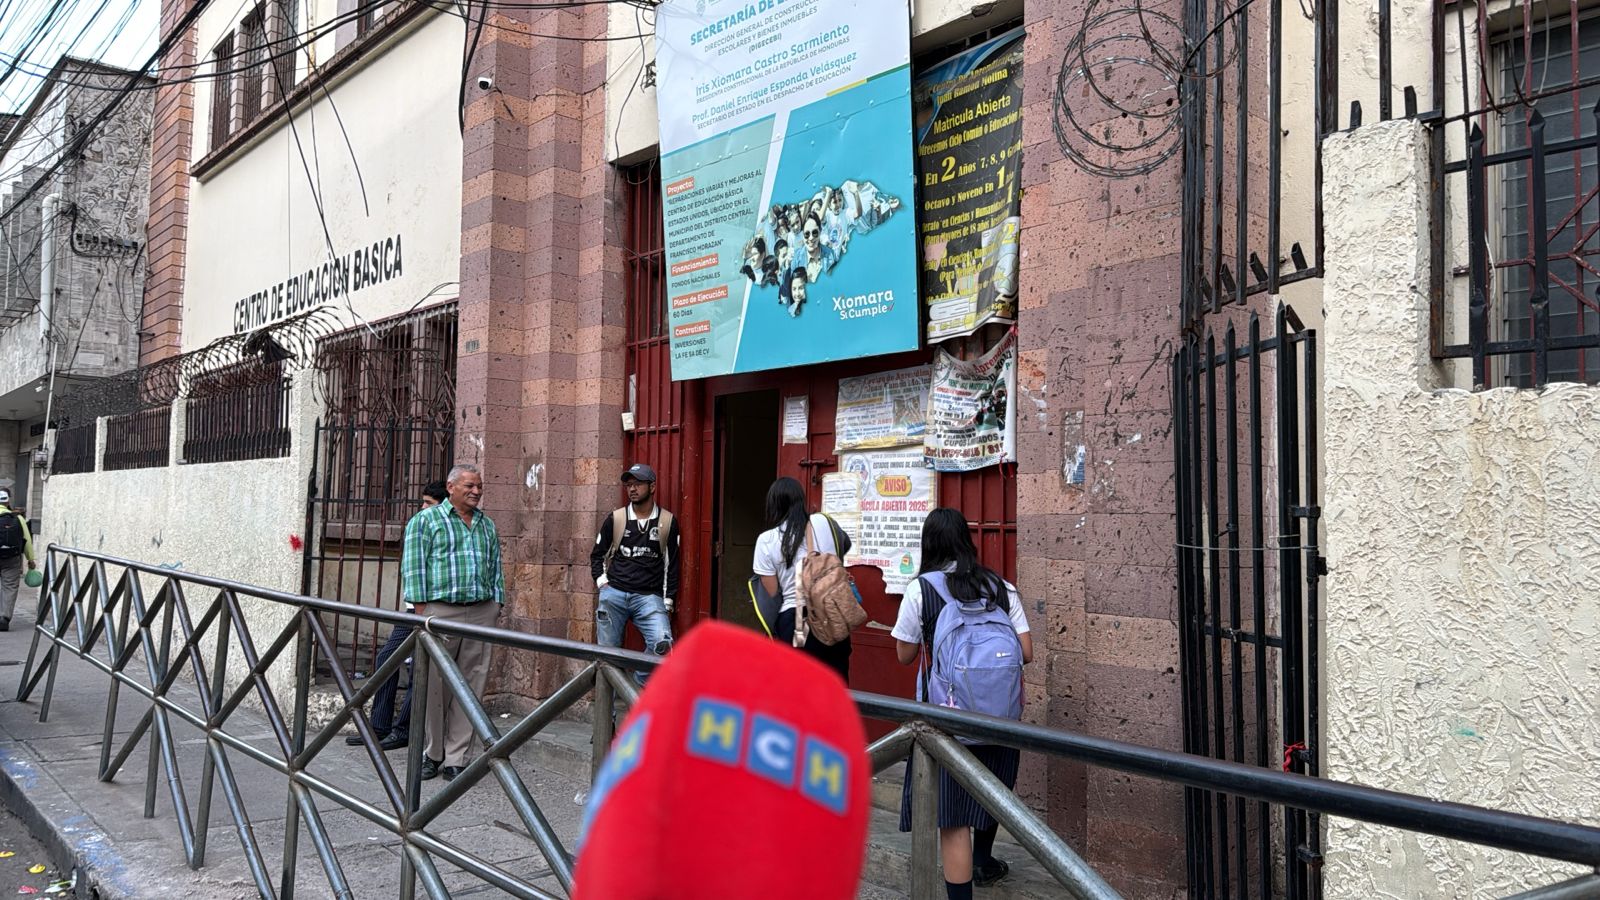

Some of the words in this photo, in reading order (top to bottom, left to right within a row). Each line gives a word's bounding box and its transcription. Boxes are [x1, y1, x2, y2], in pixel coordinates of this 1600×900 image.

[690, 4, 756, 46] SECRETARÍA
[758, 0, 774, 14] DE
[704, 32, 735, 53] DIRECCIÓN
[736, 21, 764, 38] GENERAL
[764, 15, 774, 25] DE
[774, 0, 819, 20] CONSTRUCC
[718, 36, 752, 56] ESCOLARES
[757, 23, 779, 39] BIENES
[780, 5, 818, 29] INMUEBLES
[748, 32, 782, 54] (DIGECEBI)
[695, 82, 710, 97] Iris
[711, 65, 752, 90] Xiomara
[754, 50, 789, 72] Castro
[790, 24, 850, 57] Sarmiento
[723, 72, 764, 93] CONSTITUCIONAL
[764, 68, 772, 76] DE
[772, 65, 779, 73] LA
[779, 54, 809, 70] REPÚBLICA
[809, 50, 818, 58] DE
[817, 36, 850, 54] HONDURAS
[691, 109, 709, 123] Prof.
[710, 98, 736, 116] Daniel
[736, 87, 769, 106] Enrique
[769, 71, 809, 93] Esponda
[810, 52, 857, 77] Velásquez
[697, 113, 728, 130] SECRETARIO
[727, 110, 735, 119] DE
[735, 102, 757, 114] ESTADO
[756, 99, 765, 107] EN
[765, 96, 773, 104] EL
[773, 83, 805, 101] DESPACHO
[805, 79, 814, 88] DE
[814, 65, 852, 85] EDUCACIÓN
[933, 108, 974, 135] Matricula
[975, 94, 1011, 118] Abierta
[949, 133, 963, 148] Ciclo
[925, 172, 938, 186] En
[941, 156, 956, 183] 2
[958, 162, 977, 177] Años
[1000, 150, 1006, 162] 9
[667, 179, 694, 194] Proyecto:
[706, 182, 724, 193] VARIAS
[729, 172, 755, 186] MEJORAS
[755, 168, 762, 177] AL
[924, 196, 950, 211] Octavo
[951, 195, 957, 206] y
[957, 186, 983, 203] Noveno
[984, 181, 994, 194] En
[996, 165, 1005, 190] 1
[667, 205, 687, 217] CENTRO
[687, 202, 694, 211] DE
[694, 194, 724, 209] EDUCACIÓN
[668, 215, 689, 228] ESTADOS
[709, 202, 734, 215] UBICADO
[734, 199, 742, 207] EN
[742, 197, 750, 205] EL
[941, 218, 949, 228] en
[949, 211, 970, 227] Ciencias
[970, 210, 974, 221] y
[1006, 181, 1013, 204] 1
[668, 225, 694, 238] MUNICIPIO
[694, 222, 704, 231] DEL
[704, 215, 728, 228] DISTRITO
[962, 226, 969, 237] de
[969, 222, 977, 234] 18
[669, 233, 707, 249] DEPARTAMENTO
[707, 230, 715, 238] DE
[669, 246, 696, 259] FRANCISCO
[671, 257, 718, 273] Financiamiento:
[233, 289, 268, 334] CENTRO
[270, 282, 284, 321] DE
[353, 234, 403, 291] BASICA
[671, 278, 691, 288] FONDOS
[690, 272, 721, 284] NACIONALES
[673, 297, 689, 307] Plazo
[689, 295, 697, 303] de
[832, 289, 894, 311] Xiomara
[672, 311, 680, 319] 60
[675, 323, 710, 337] Contratista:
[675, 337, 706, 349] INVERSIONES
[675, 352, 682, 360] LA
[703, 347, 710, 355] CV
[884, 478, 907, 492] AVISO
[881, 500, 907, 512] ABIERTA
[697, 709, 842, 797] HCH
